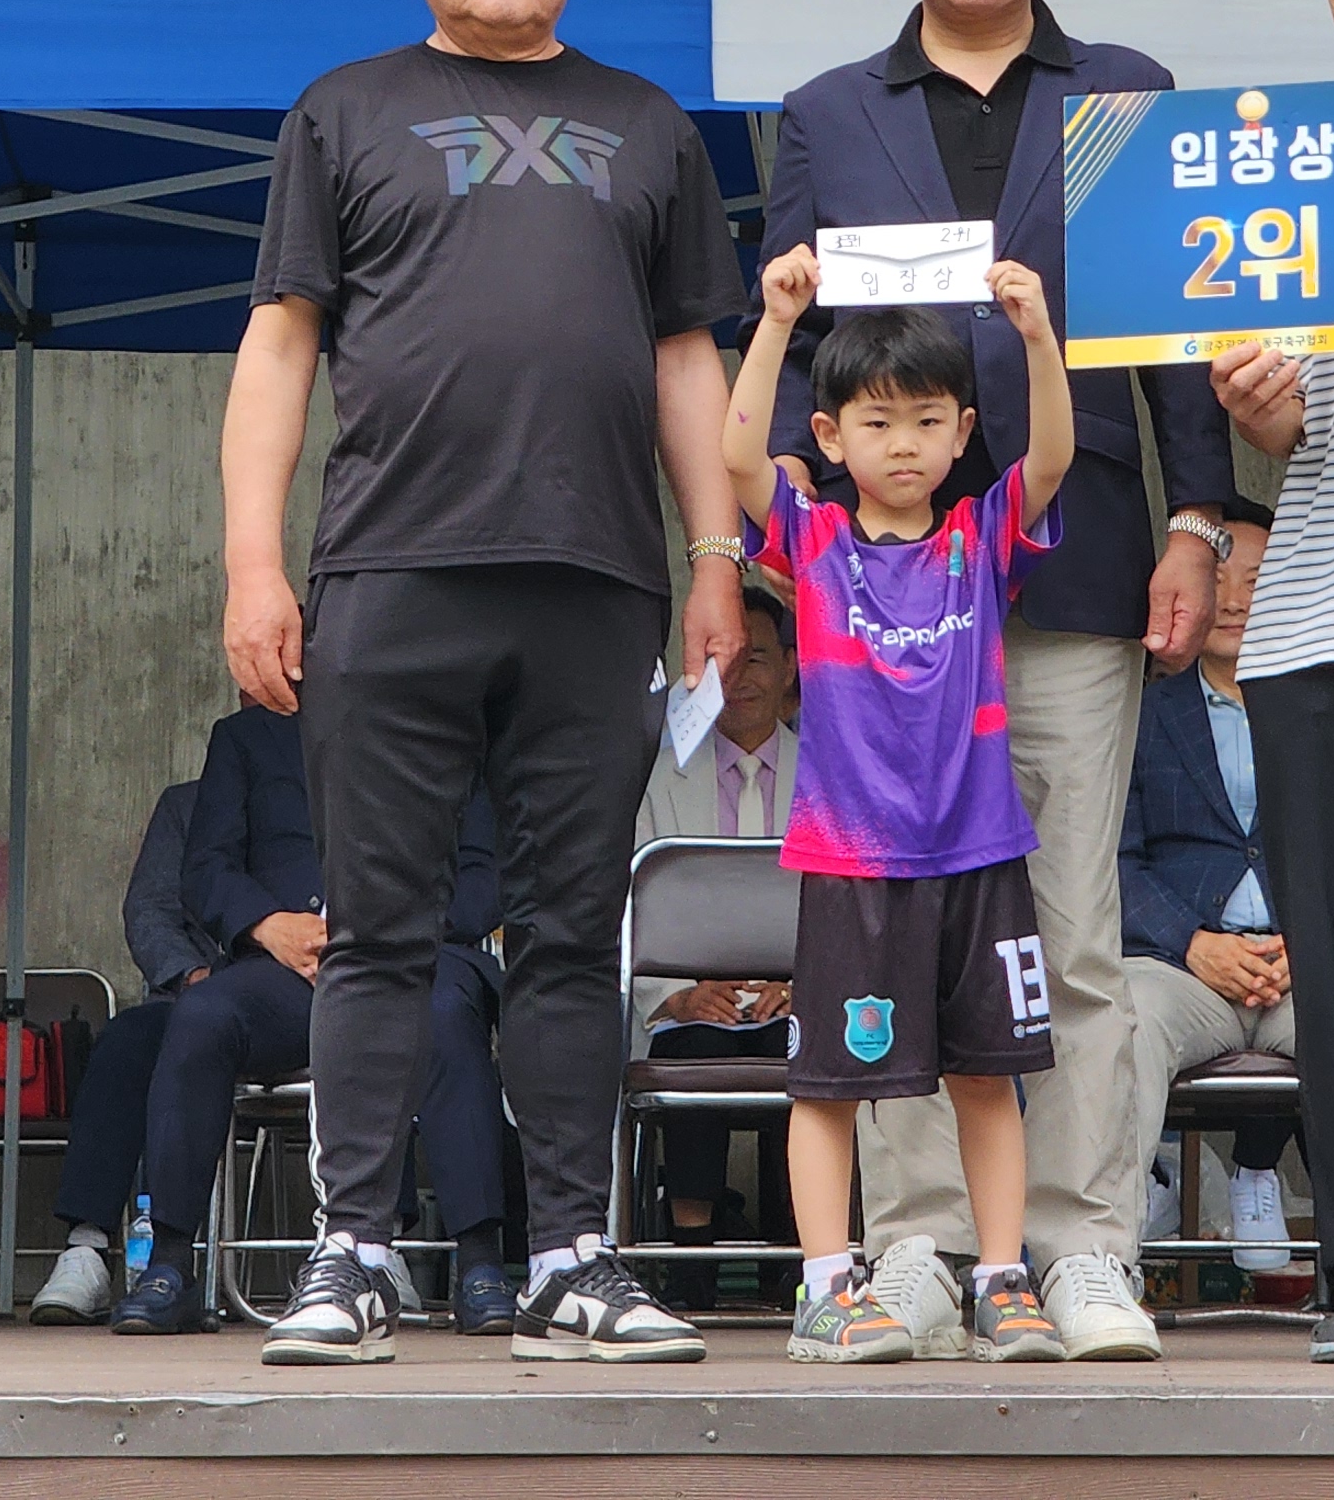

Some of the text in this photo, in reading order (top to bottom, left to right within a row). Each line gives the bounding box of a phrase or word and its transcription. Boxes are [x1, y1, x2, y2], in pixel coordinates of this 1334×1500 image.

[940, 227, 971, 243] 2위
[1182, 204, 1320, 301] 2위
[994, 934, 1051, 1020] 13
